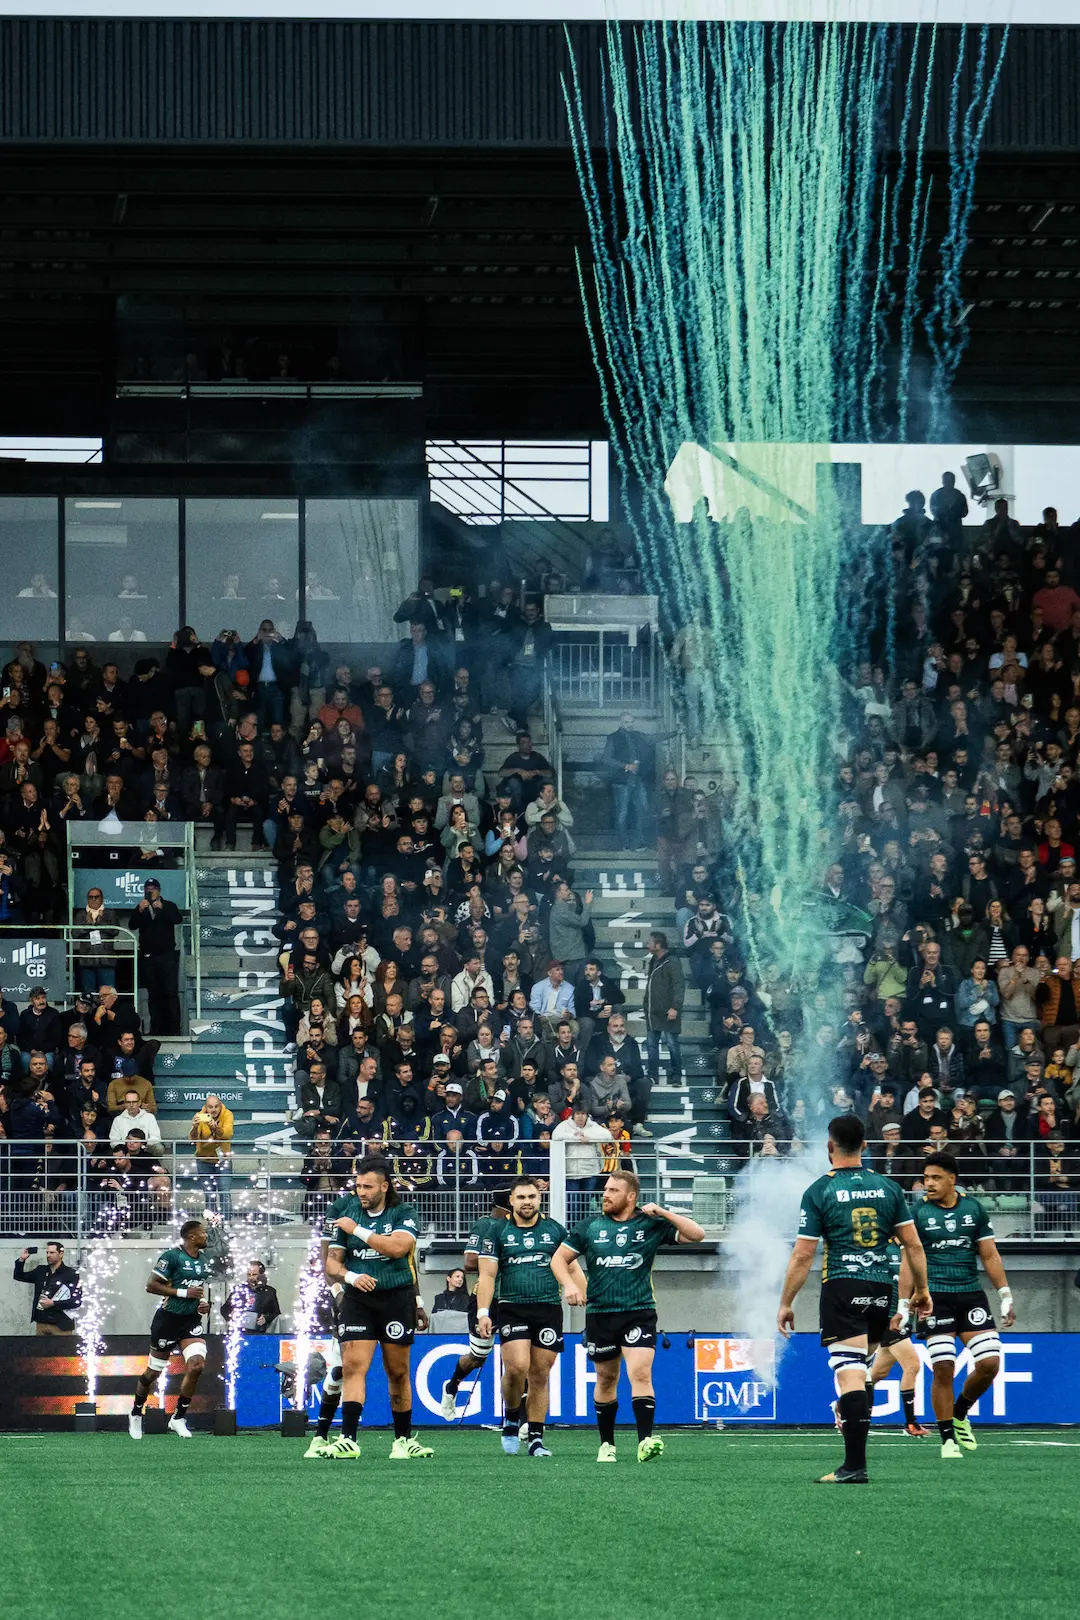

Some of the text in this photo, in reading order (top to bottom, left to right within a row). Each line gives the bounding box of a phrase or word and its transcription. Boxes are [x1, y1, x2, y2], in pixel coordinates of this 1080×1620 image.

[26, 964, 47, 978] GB
[851, 1189, 886, 1200] FAUCHÉ
[702, 1381, 768, 1407] GMF
